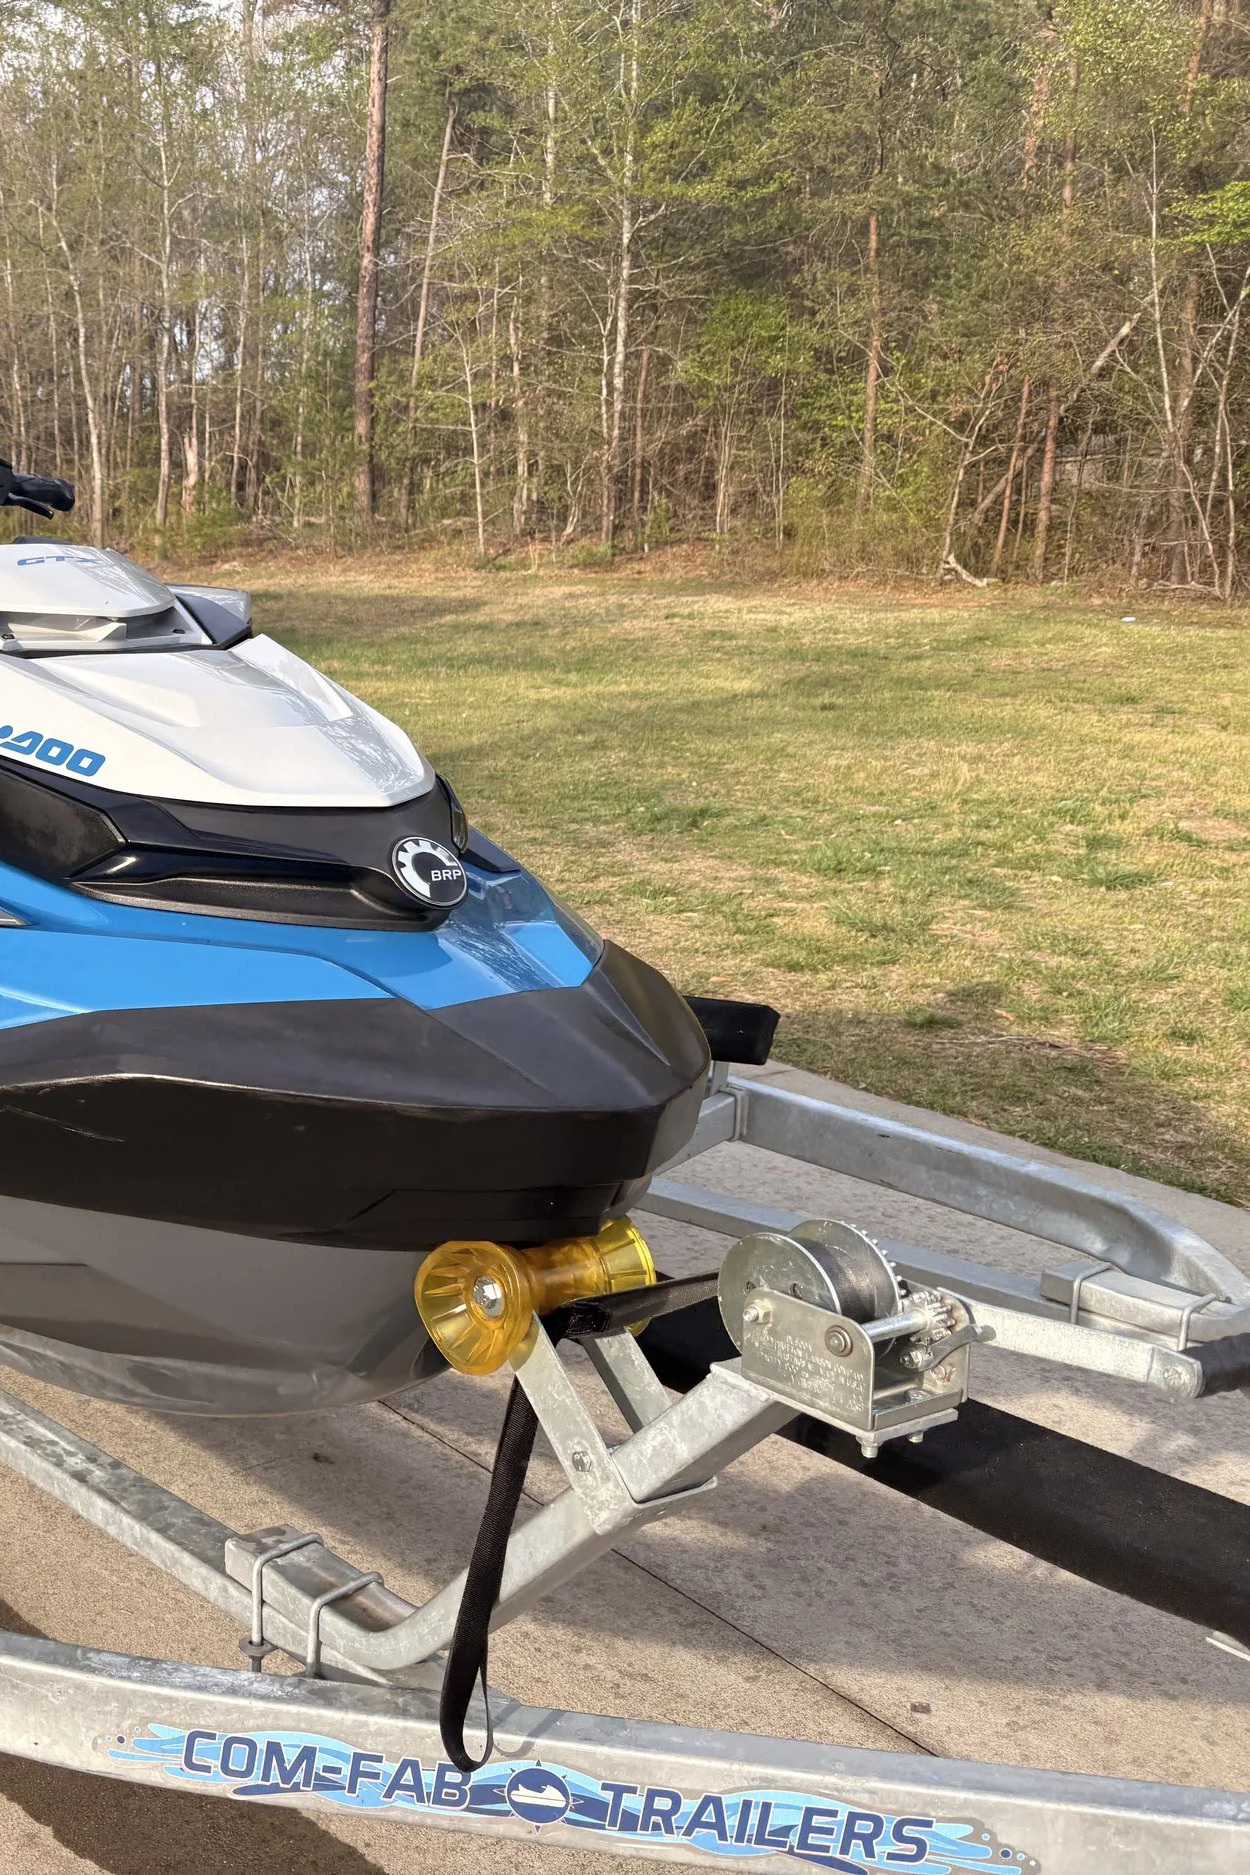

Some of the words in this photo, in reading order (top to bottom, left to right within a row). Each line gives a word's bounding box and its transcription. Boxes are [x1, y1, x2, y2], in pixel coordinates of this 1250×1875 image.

[431, 869, 462, 881] BRP
[183, 1730, 472, 1809] COM-FAB
[600, 1781, 935, 1864] TRAILERS
